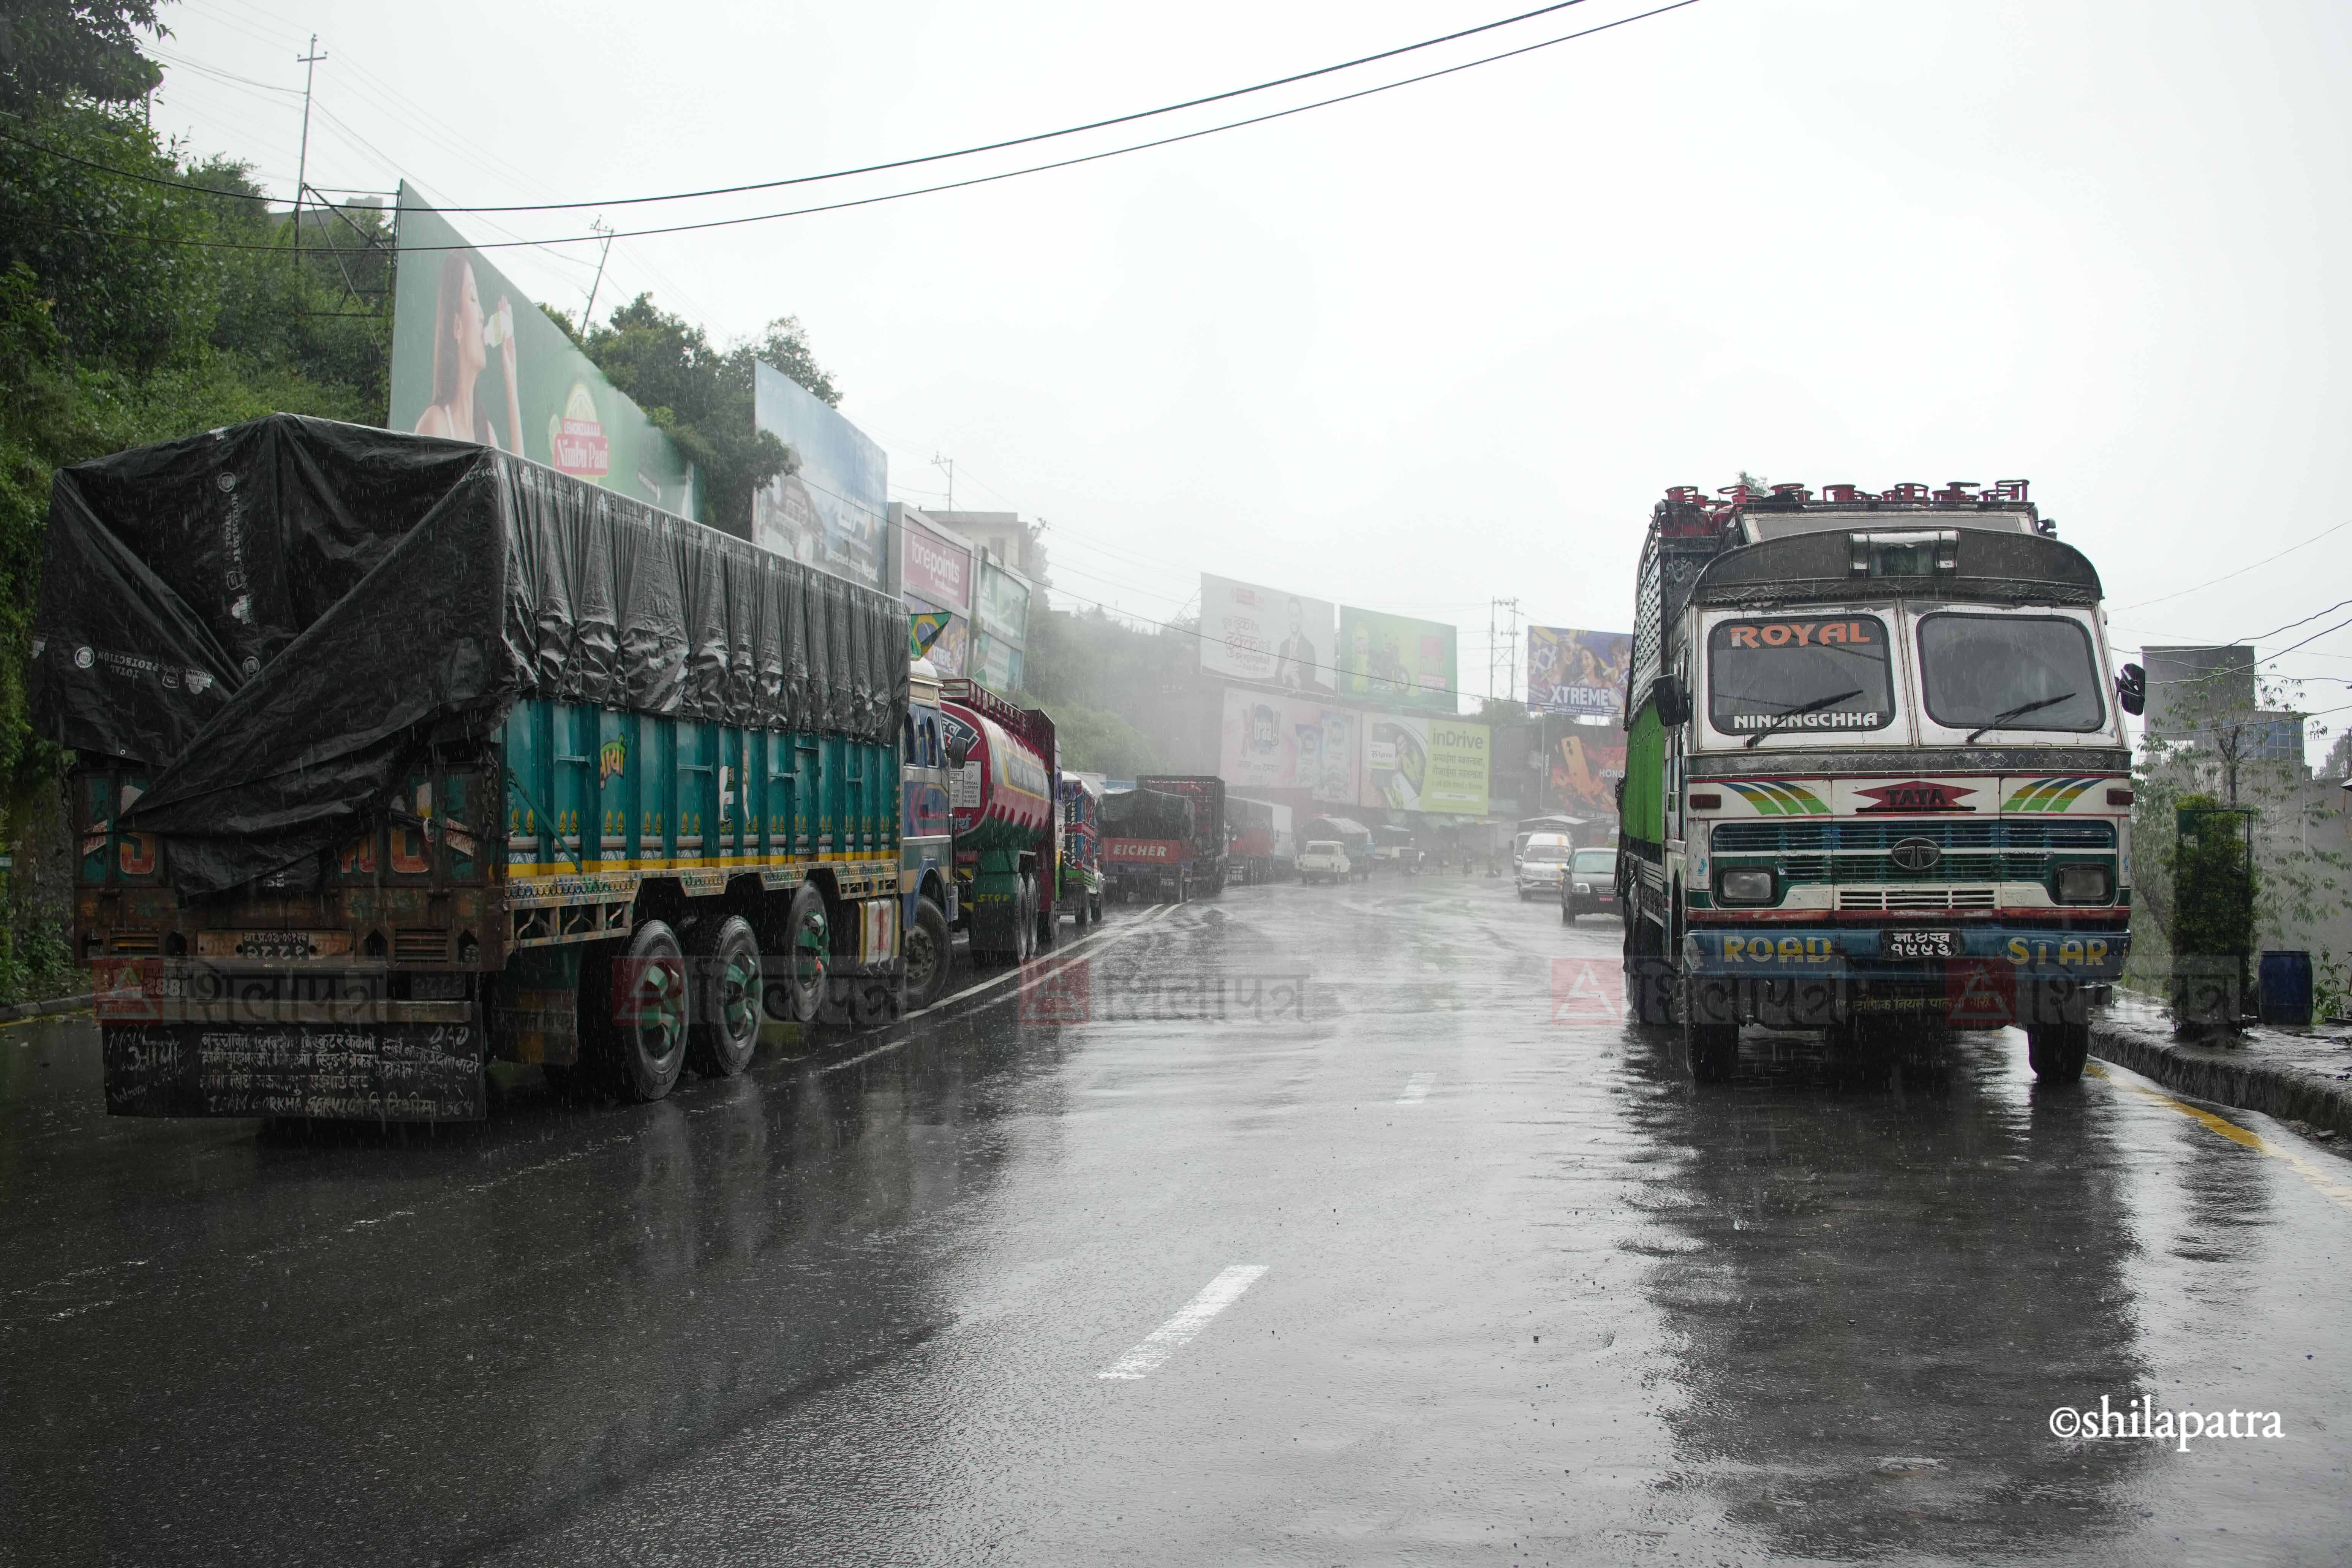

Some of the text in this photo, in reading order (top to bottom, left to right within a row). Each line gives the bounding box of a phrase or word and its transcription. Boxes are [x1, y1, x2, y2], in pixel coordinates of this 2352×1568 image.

[557, 438, 608, 469] Nimbu Pani
[912, 534, 960, 584] fonepoints
[1730, 623, 1871, 648] ROYAL
[97, 651, 158, 672] PROTECTION
[110, 665, 139, 679] TOTAL
[1550, 685, 1609, 707] XTREME
[1433, 728, 1483, 749] inDrive
[1599, 769, 1625, 778] HONO
[1885, 788, 1946, 805] TATA
[1114, 844, 1167, 857] EICHER
[1723, 936, 1833, 964] ROAD
[2007, 936, 2108, 966] STAR
[1895, 997, 1924, 1010] नियम
[251, 1094, 303, 1116] GORKHA
